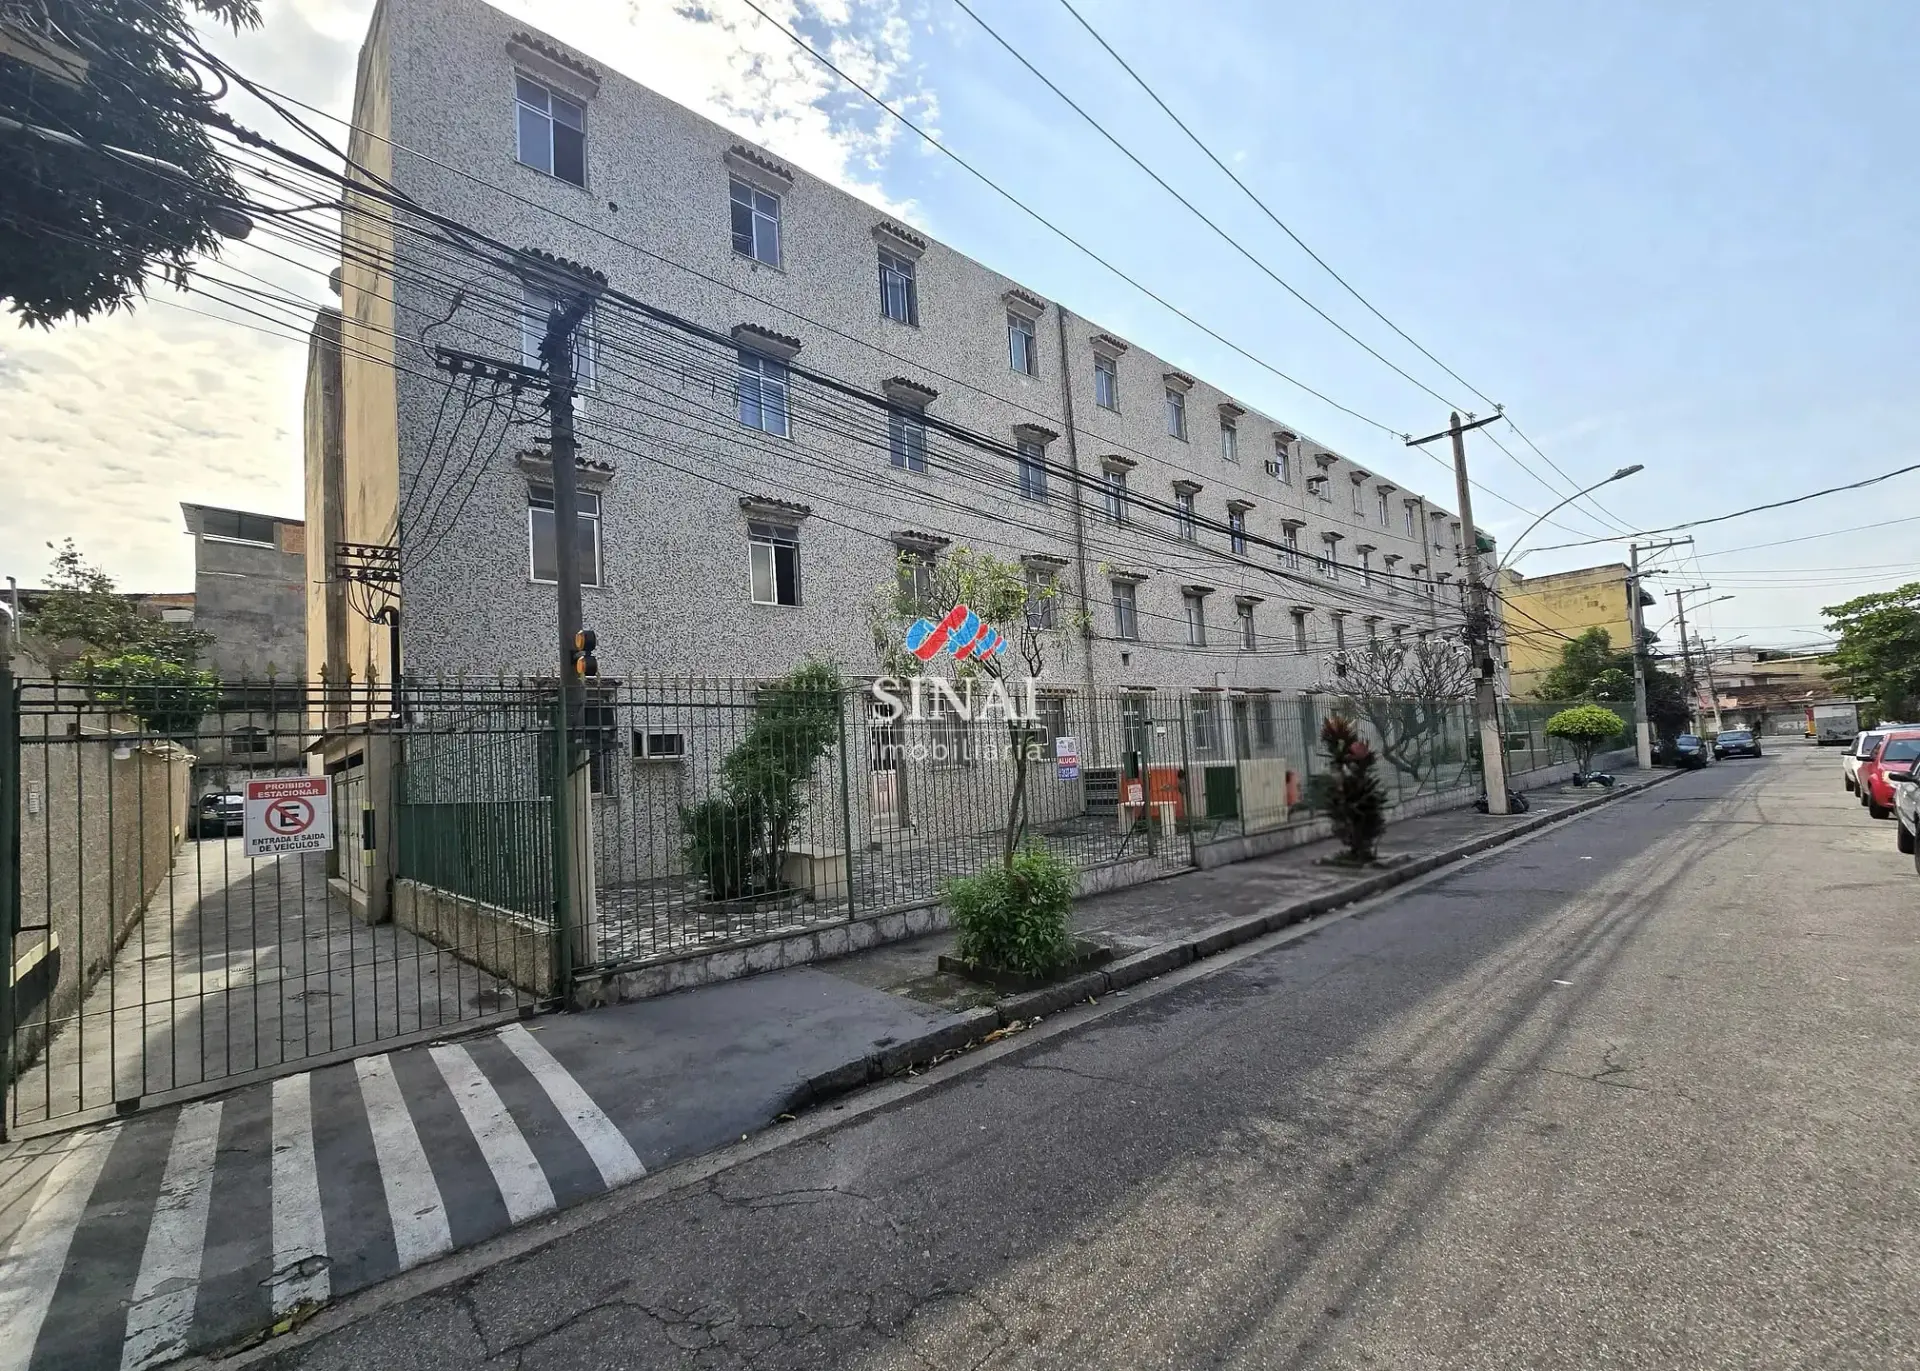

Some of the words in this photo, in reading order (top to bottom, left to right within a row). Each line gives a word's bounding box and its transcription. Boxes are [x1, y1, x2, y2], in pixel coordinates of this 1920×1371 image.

[265, 782, 311, 790] PROIBIDO
[258, 788, 319, 798] ESTACIONAR
[252, 836, 291, 846] ENTRADA
